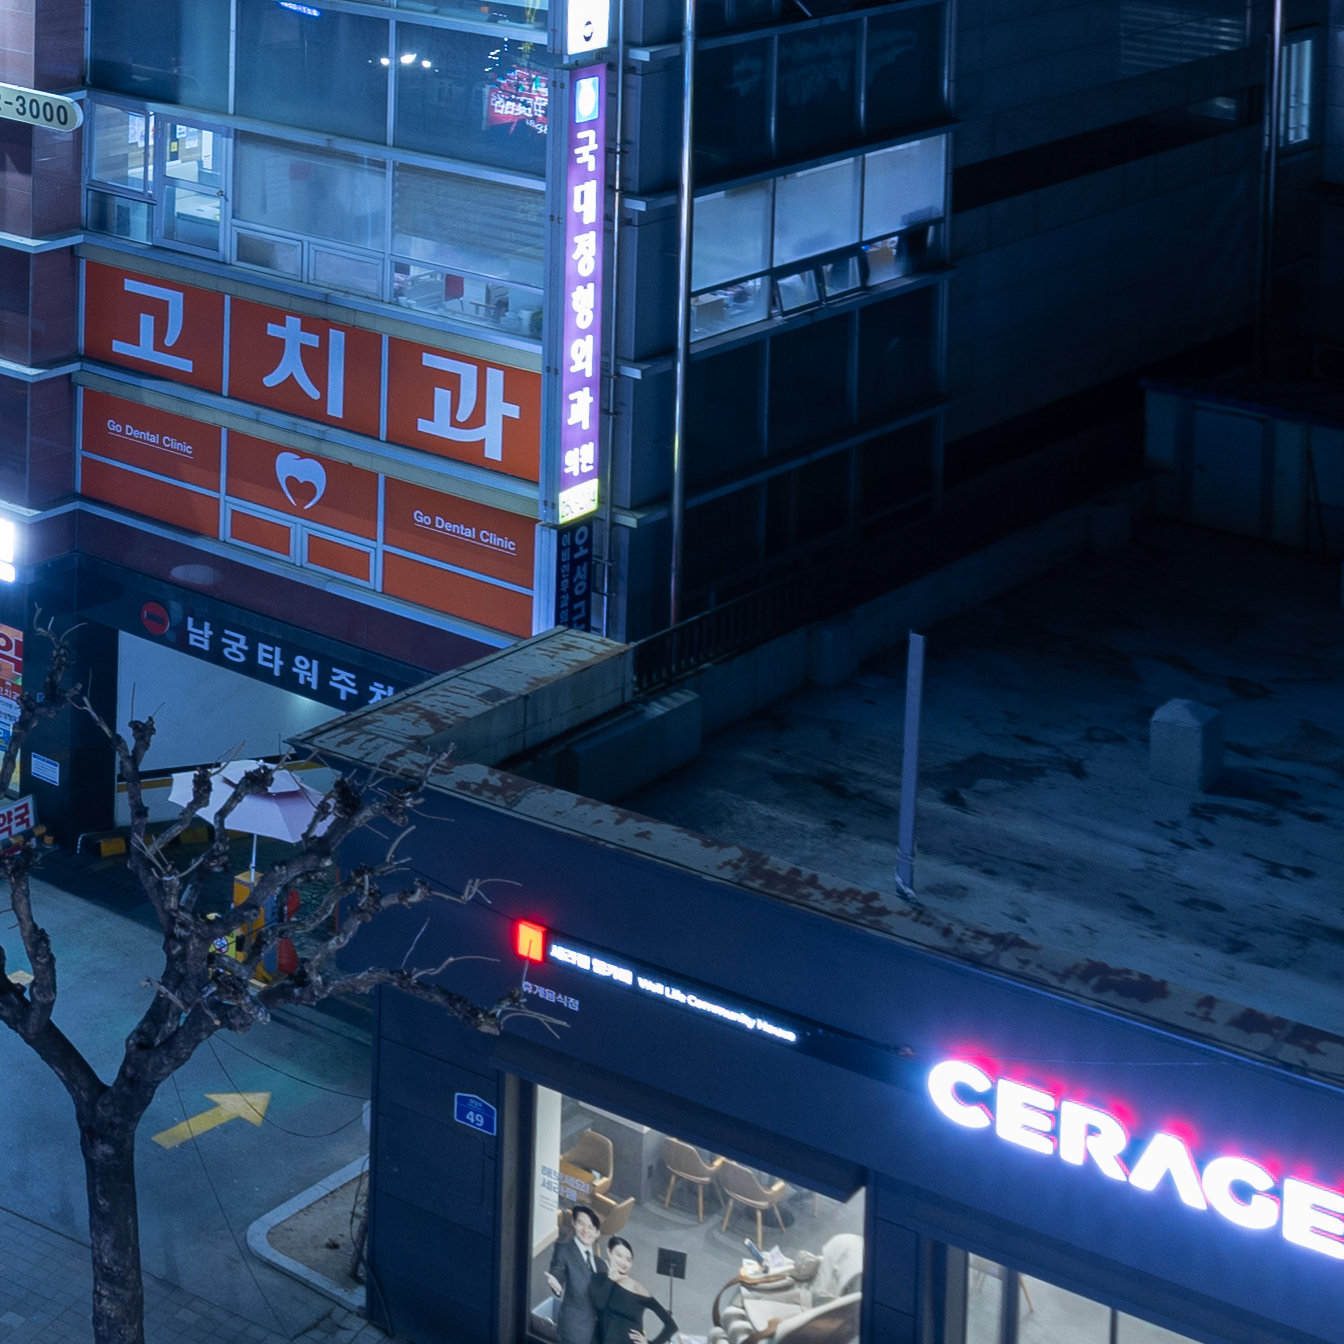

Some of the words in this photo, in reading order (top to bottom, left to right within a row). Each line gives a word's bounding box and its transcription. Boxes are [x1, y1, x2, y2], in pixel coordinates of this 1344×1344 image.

[567, 129, 599, 431] 국대정형외과
[113, 278, 520, 461] 고치과
[107, 419, 122, 435] Go
[125, 425, 160, 445] Dental
[162, 433, 193, 455] Clinic
[563, 441, 594, 477] 의원
[413, 509, 431, 527] Go
[434, 514, 476, 539] Dental
[479, 525, 517, 551] Clinic
[522, 981, 579, 1011] 휴게음식점
[687, 995, 756, 1029] Community
[466, 1111, 484, 1127] 49
[928, 1059, 1344, 1260] CERAGE
